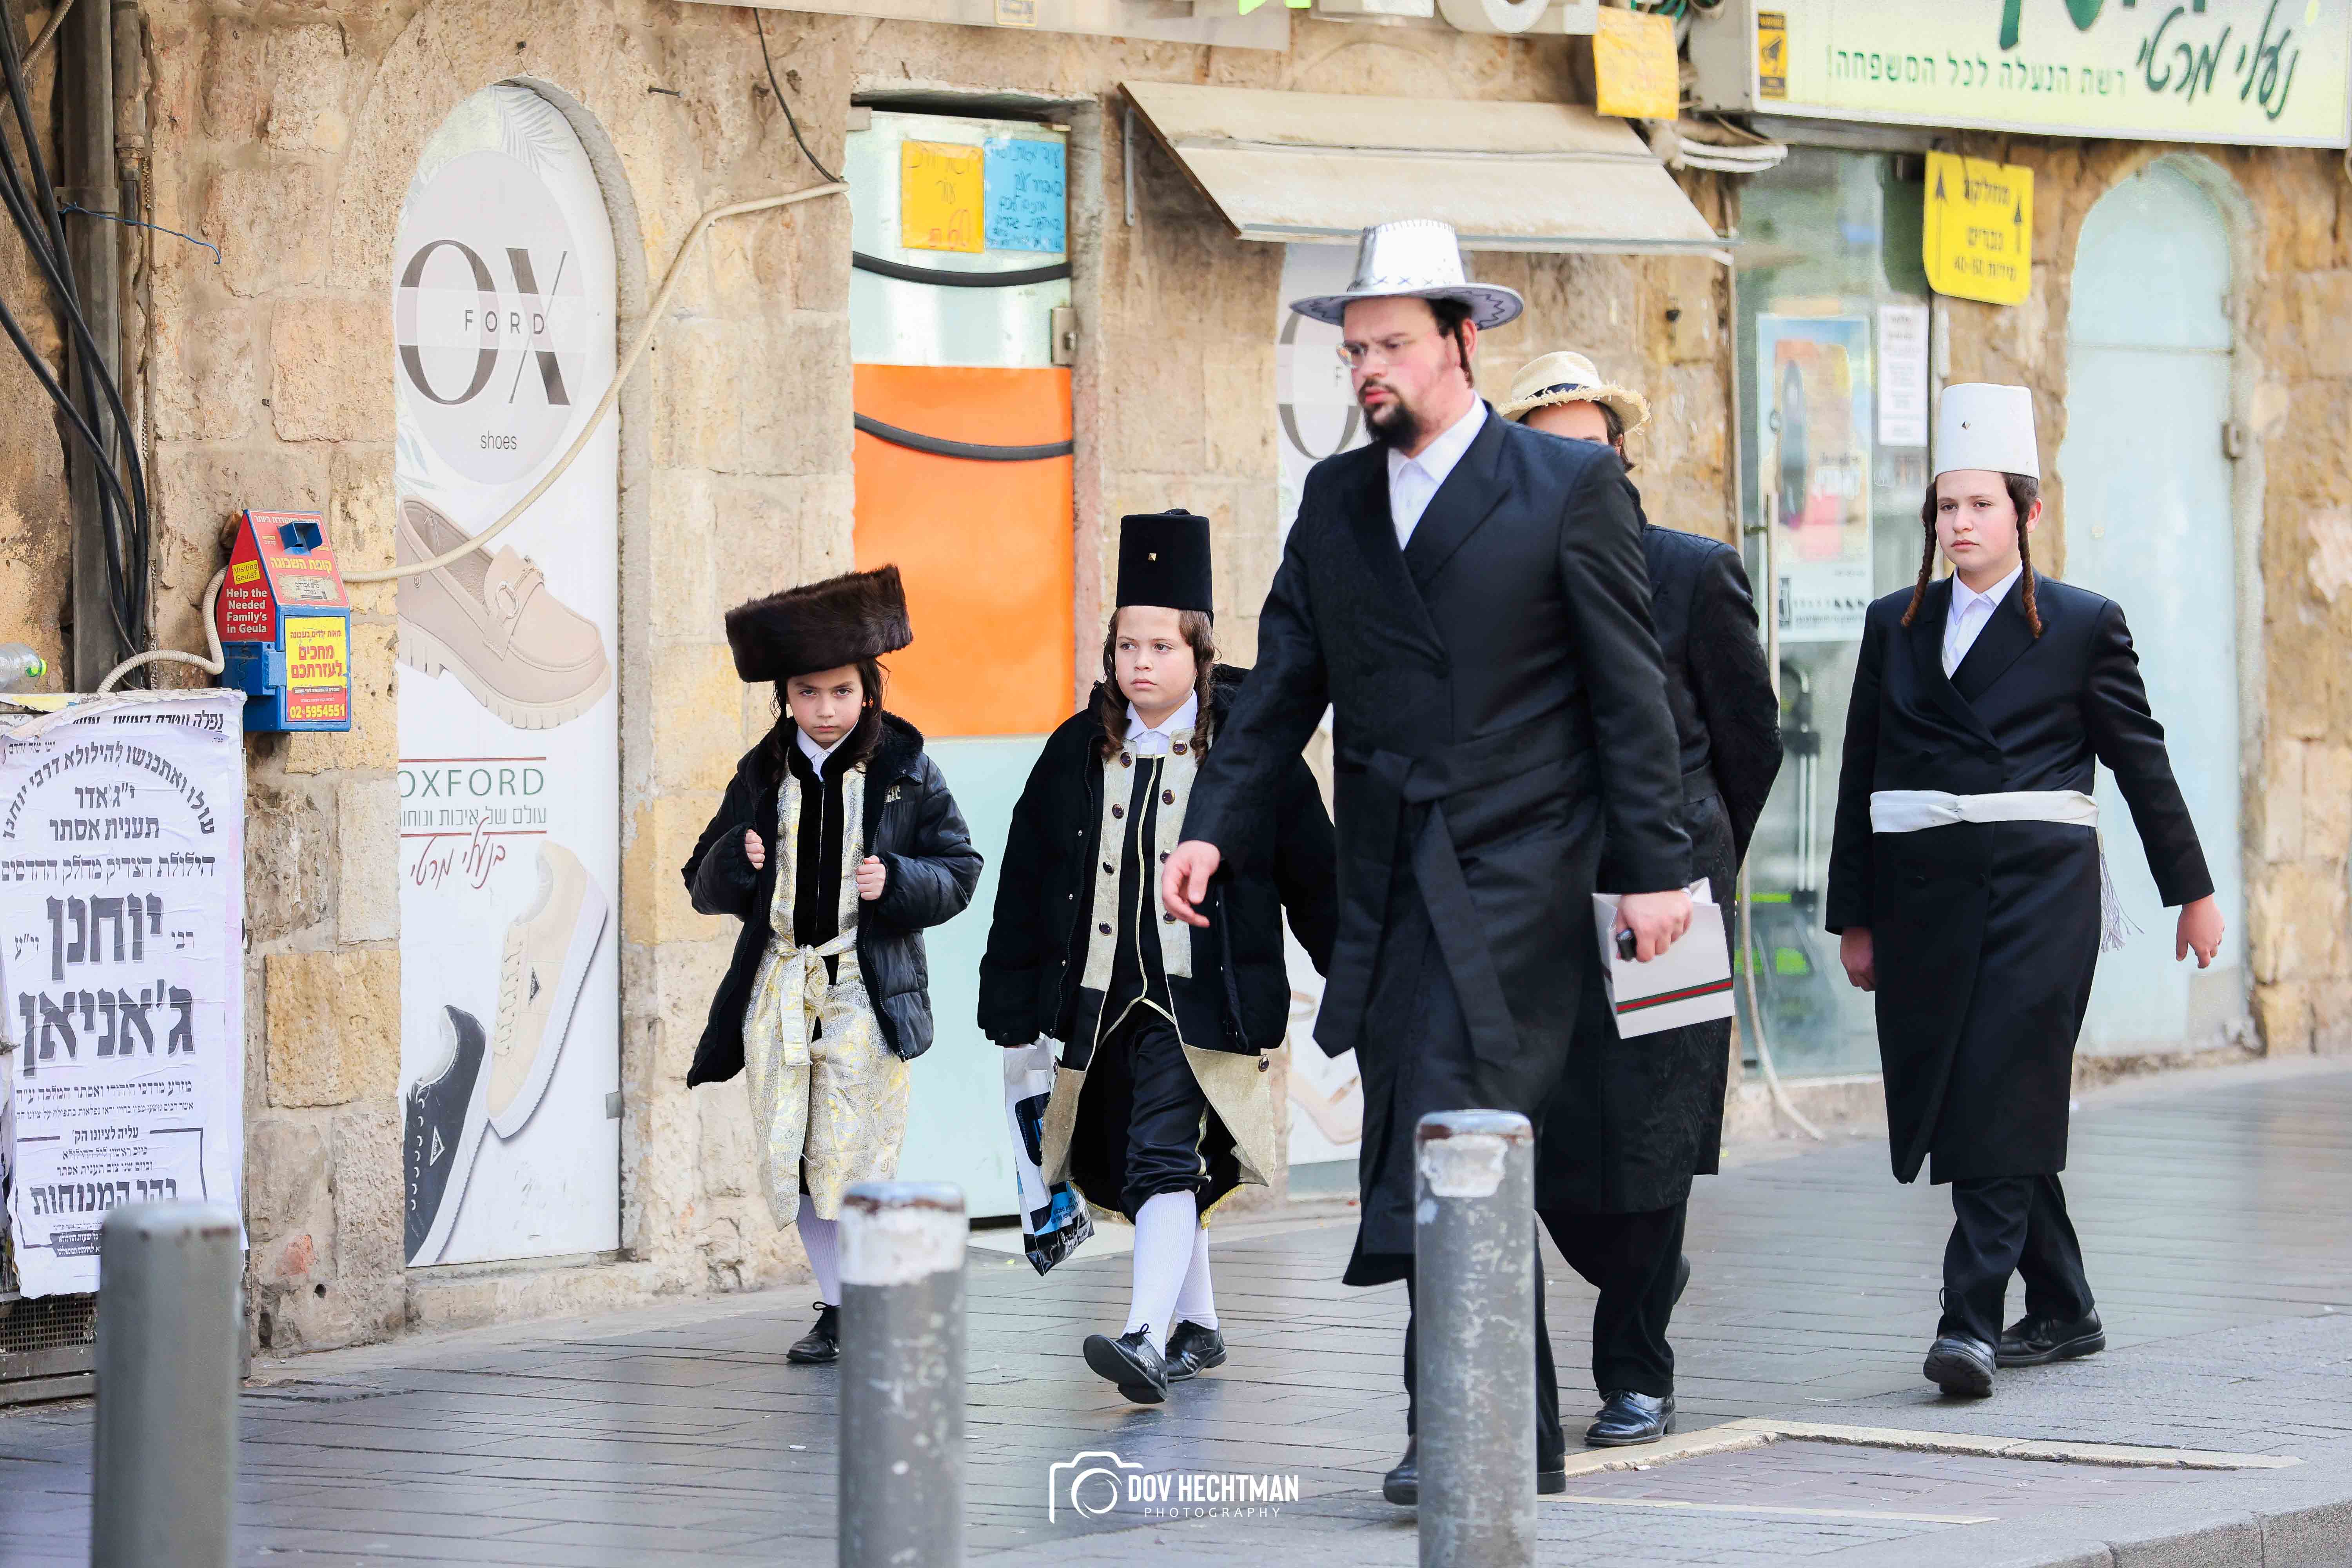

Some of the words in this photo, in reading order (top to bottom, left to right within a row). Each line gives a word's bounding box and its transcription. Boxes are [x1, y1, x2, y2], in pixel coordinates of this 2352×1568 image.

[1947, 49, 1988, 87] לכל
[2000, 56, 2071, 93] הנעלה
[2080, 67, 2126, 95] רשת
[396, 240, 570, 405] OX
[465, 310, 544, 334] FORD
[480, 430, 517, 449] shoes
[234, 564, 258, 574] Visiting
[269, 557, 307, 570] השכונה
[308, 559, 332, 574] קופת
[236, 571, 258, 582] Geula?
[226, 588, 249, 600] Help
[251, 588, 267, 597] the
[228, 600, 265, 610] Needed
[227, 612, 267, 623] Family's
[227, 624, 236, 633] in
[239, 623, 267, 633] Geula
[290, 631, 310, 639] בשכונה
[299, 645, 334, 660] מחכים
[291, 660, 342, 679] לעזרתכם
[193, 710, 223, 730] נפלה
[64, 740, 123, 770] להילולא
[29, 757, 60, 788] דרבי
[126, 745, 188, 794] ואתכנשו
[397, 768, 544, 798] OXFORD
[75, 786, 108, 809] אדר
[3, 784, 27, 839] יוחנן
[187, 786, 215, 835] עולו
[400, 810, 432, 827] ונוחו
[439, 809, 479, 826] איכות
[486, 806, 506, 824] של
[513, 804, 546, 824] עולם
[49, 818, 100, 841] אסתר
[105, 817, 159, 841] תענית
[62, 855, 102, 887] מחלק
[107, 856, 152, 887] הצדיק
[157, 851, 216, 878] הילולת
[46, 891, 163, 982] יוחנן
[171, 931, 194, 949] רבי
[18, 979, 196, 1079] ג'אניאן
[38, 1085, 71, 1102] המלכה
[74, 1085, 103, 1099] ואסתר
[106, 1083, 135, 1097] היהודי
[138, 1082, 165, 1095] מרדכי
[167, 1080, 192, 1097] מזרע
[53, 1105, 76, 1118] בתפילה
[78, 1103, 100, 1116] נפלאות
[164, 1103, 177, 1111] רבים
[179, 1102, 194, 1110] אשר
[90, 1126, 116, 1142] לציונו
[118, 1125, 139, 1139] עליה
[63, 1149, 94, 1161] ההילולא
[110, 1146, 131, 1161] ראשון
[132, 1145, 147, 1156] ביום
[57, 1165, 78, 1176] אסתר
[81, 1163, 104, 1176] תענית
[107, 1163, 118, 1174] צום
[121, 1162, 133, 1172] שני
[135, 1161, 153, 1172] וביום
[29, 1179, 130, 1216] המנוחות
[77, 1233, 91, 1243] שעות
[92, 1232, 99, 1240] כל
